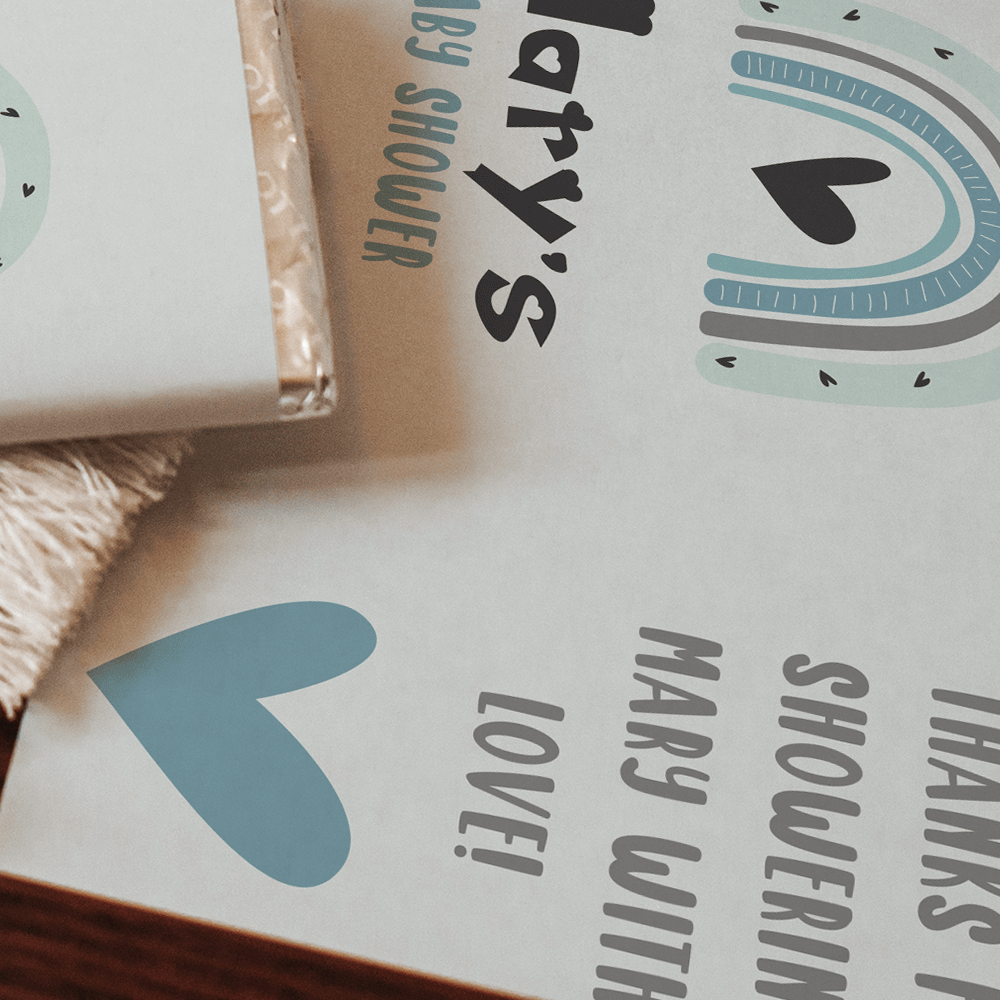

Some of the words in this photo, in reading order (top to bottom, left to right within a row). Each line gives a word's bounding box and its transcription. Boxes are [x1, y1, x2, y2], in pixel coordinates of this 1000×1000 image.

[361, 83, 462, 269] SHOWER
[454, 691, 564, 876] LOVE!
[619, 627, 724, 806] MARY
